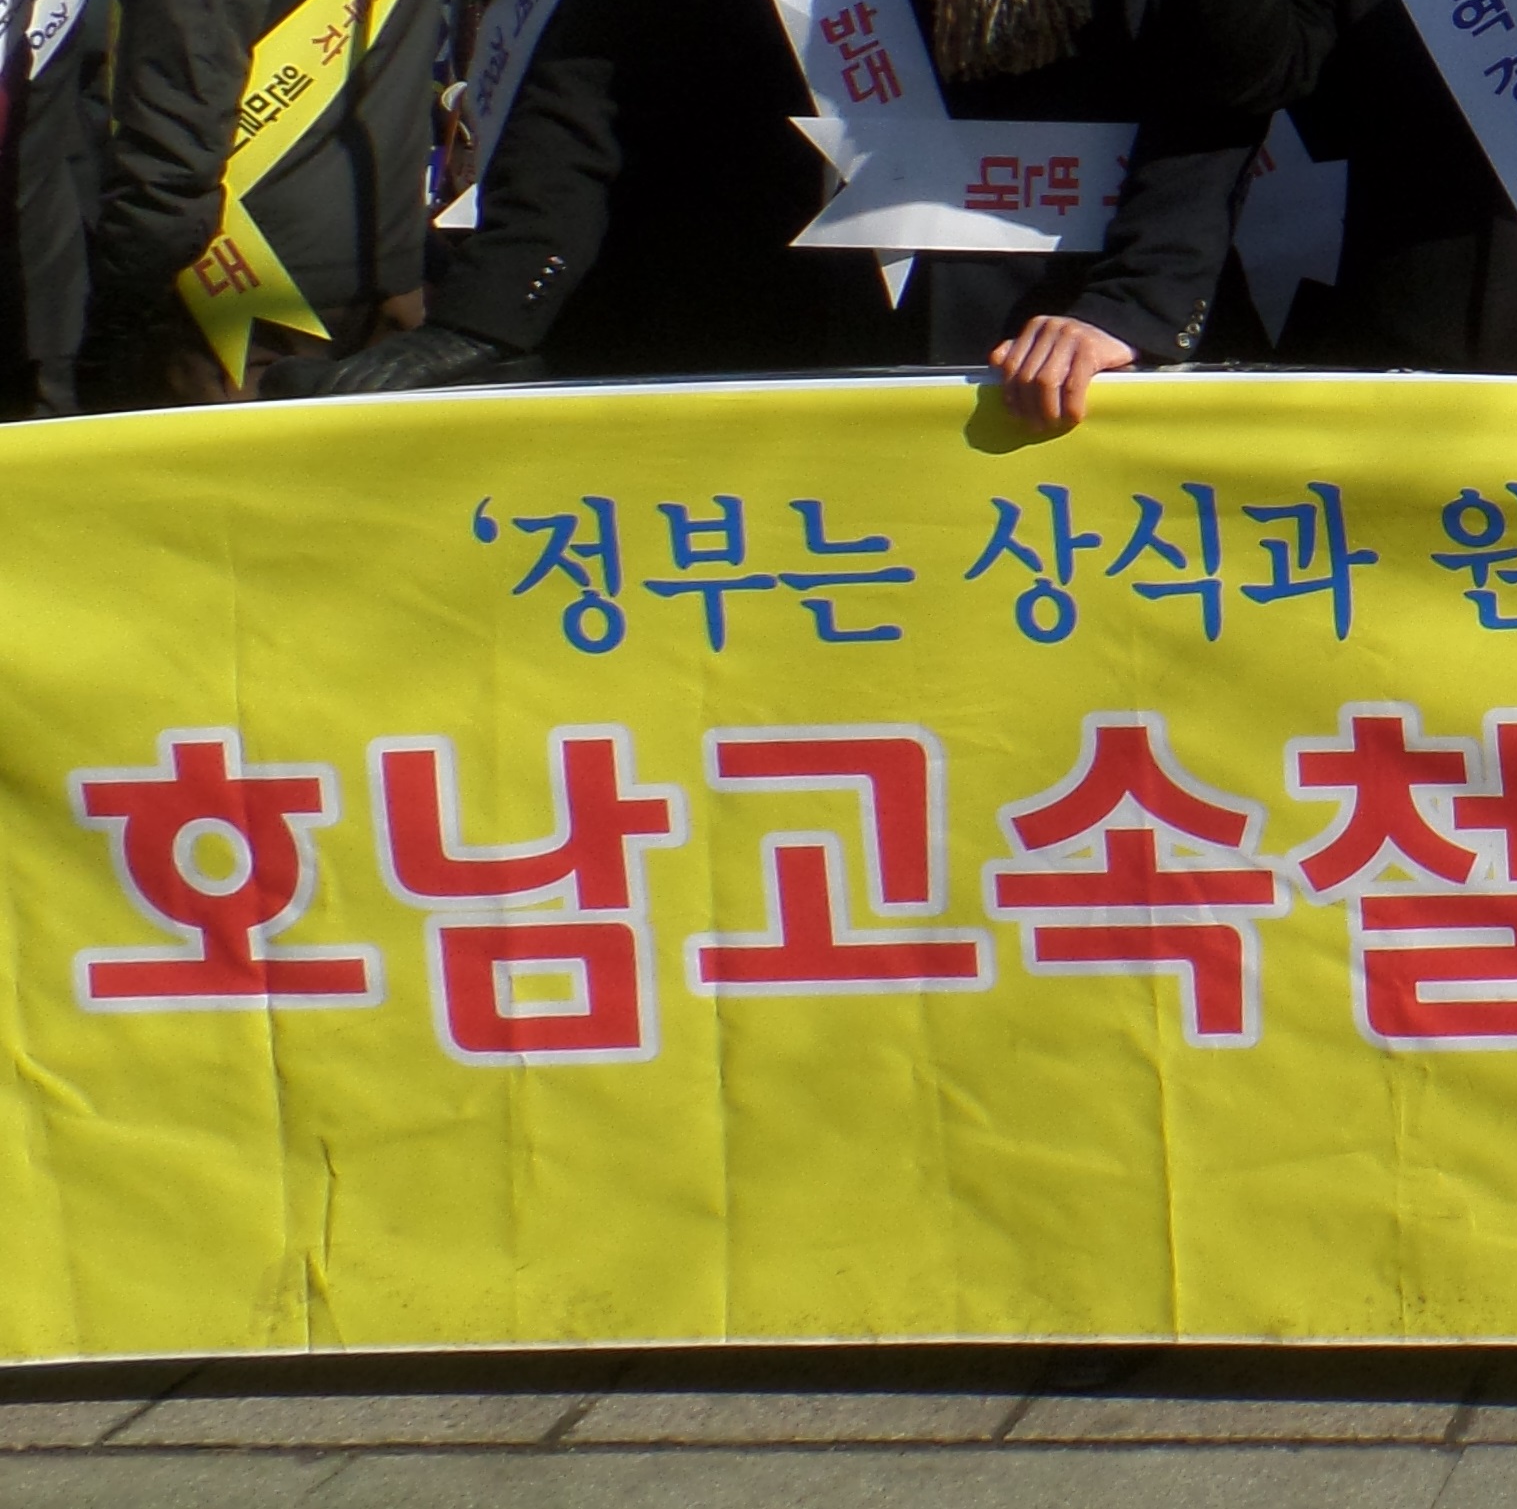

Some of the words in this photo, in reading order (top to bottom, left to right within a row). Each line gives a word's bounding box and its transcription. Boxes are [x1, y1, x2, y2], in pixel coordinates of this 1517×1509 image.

[820, 1, 902, 105] 반대
[964, 155, 1080, 216] 반대
[963, 481, 1378, 645] 상식과
